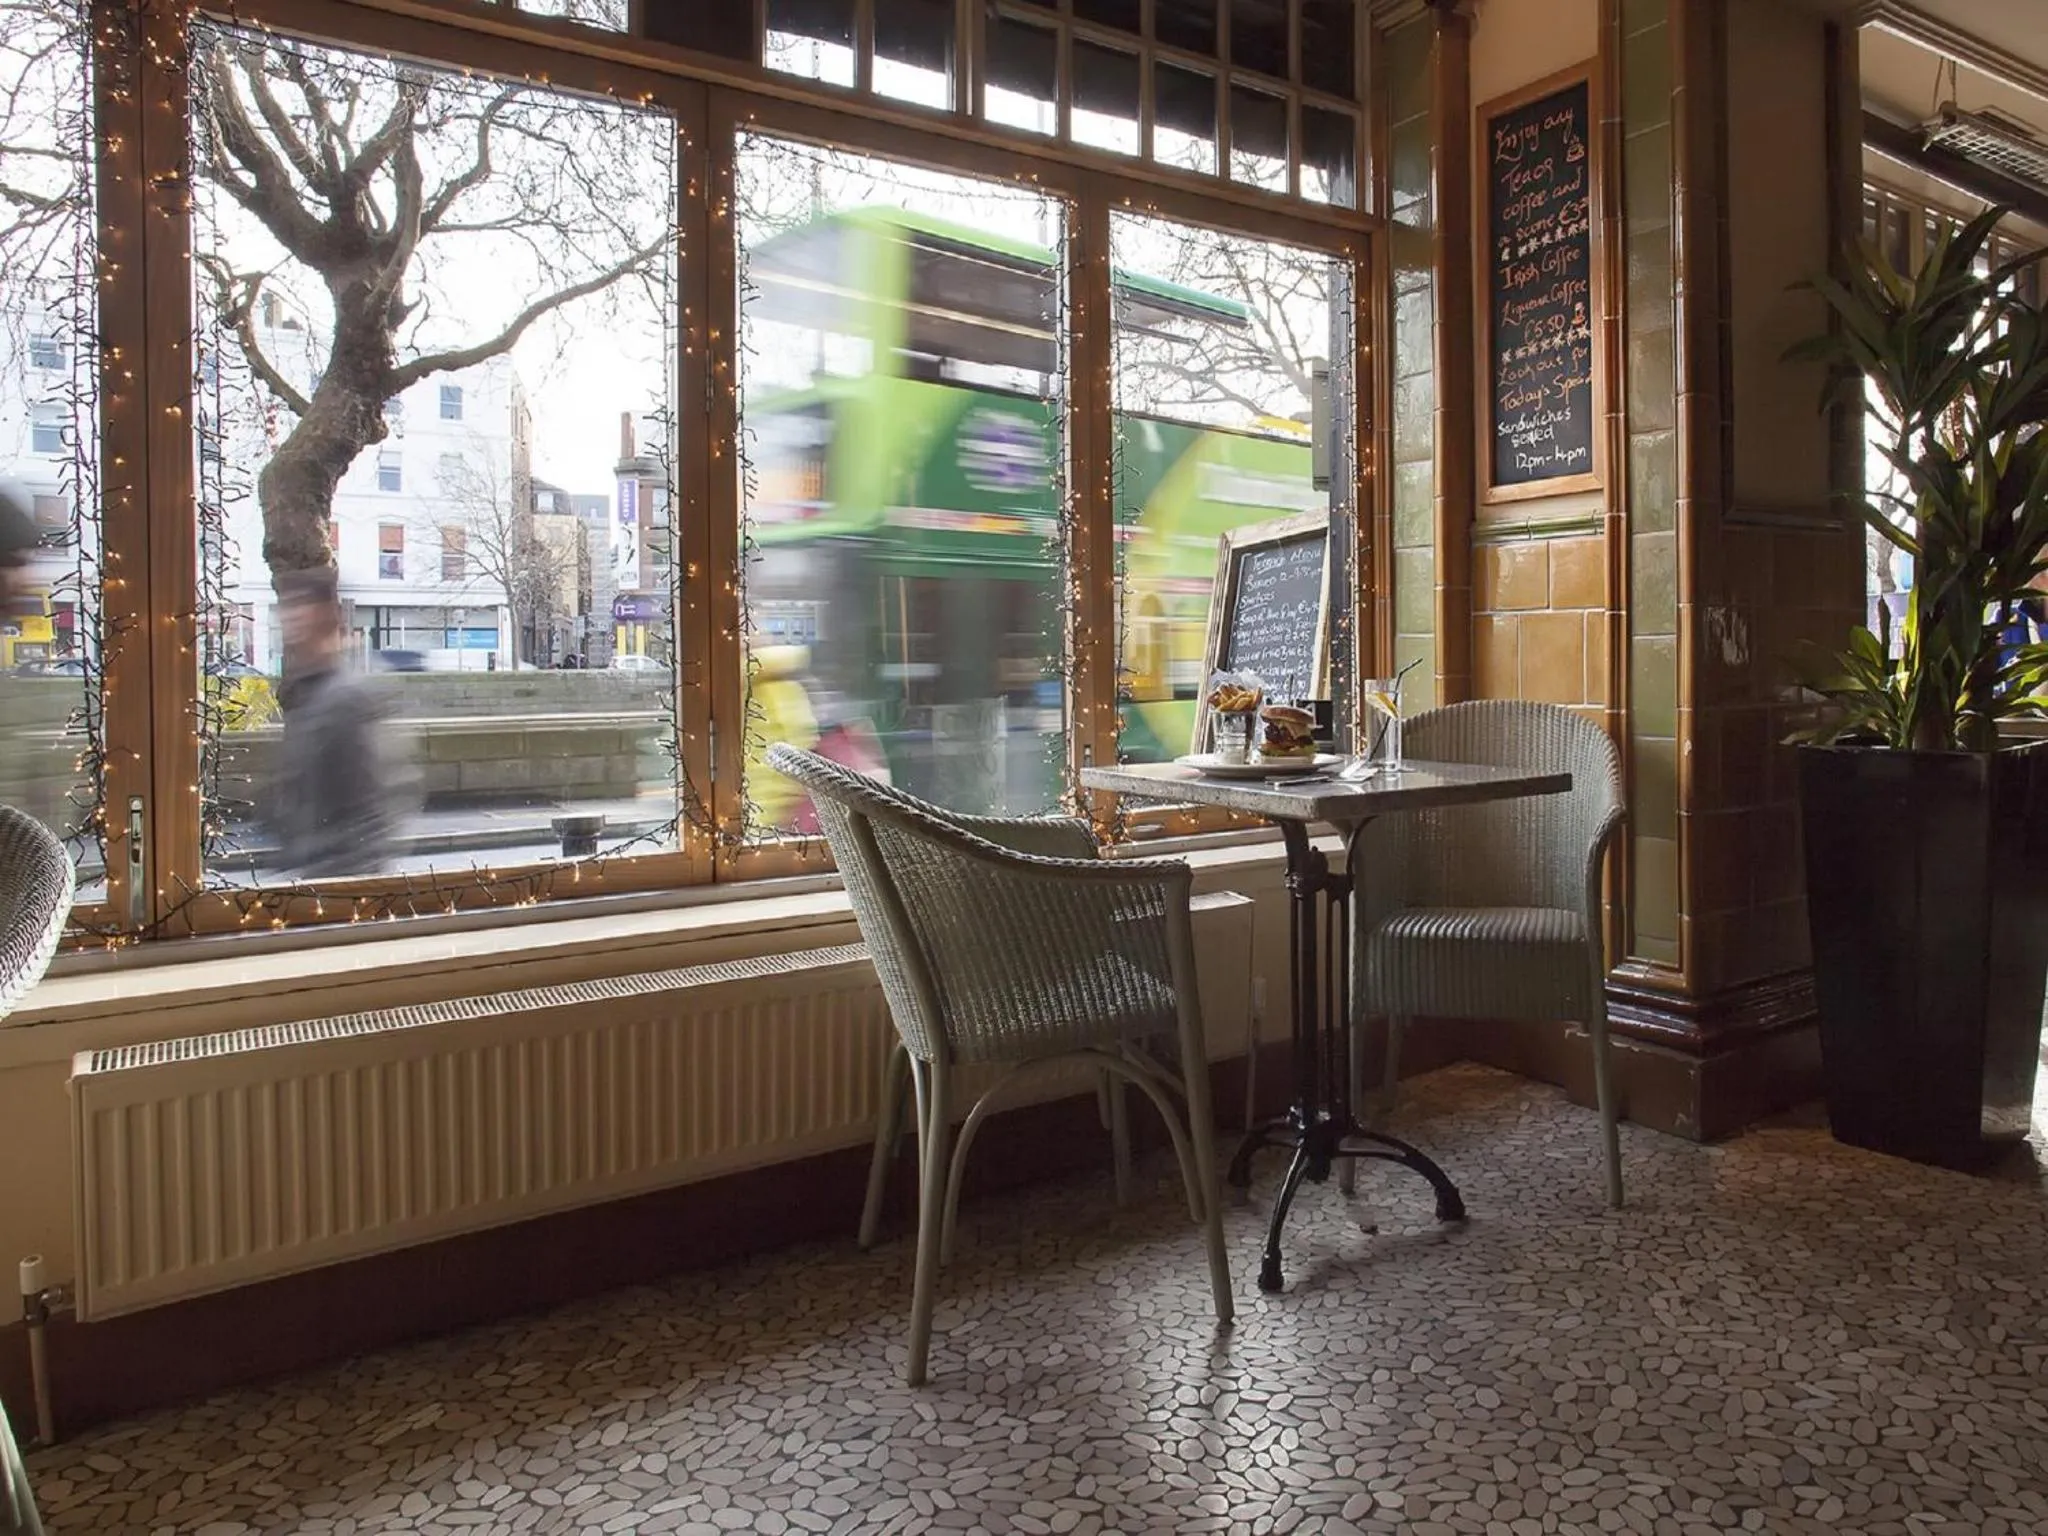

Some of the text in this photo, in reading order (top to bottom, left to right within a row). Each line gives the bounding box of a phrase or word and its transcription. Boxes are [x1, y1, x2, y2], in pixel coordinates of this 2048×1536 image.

[1494, 107, 1573, 164] Enjoy any
[1552, 166, 1582, 198] and
[1516, 214, 1555, 241] scone
[1542, 245, 1580, 276] Coffee
[1551, 280, 1586, 306] Coffee
[1500, 385, 1550, 411] Today's
[1498, 407, 1571, 436] Sandwiches
